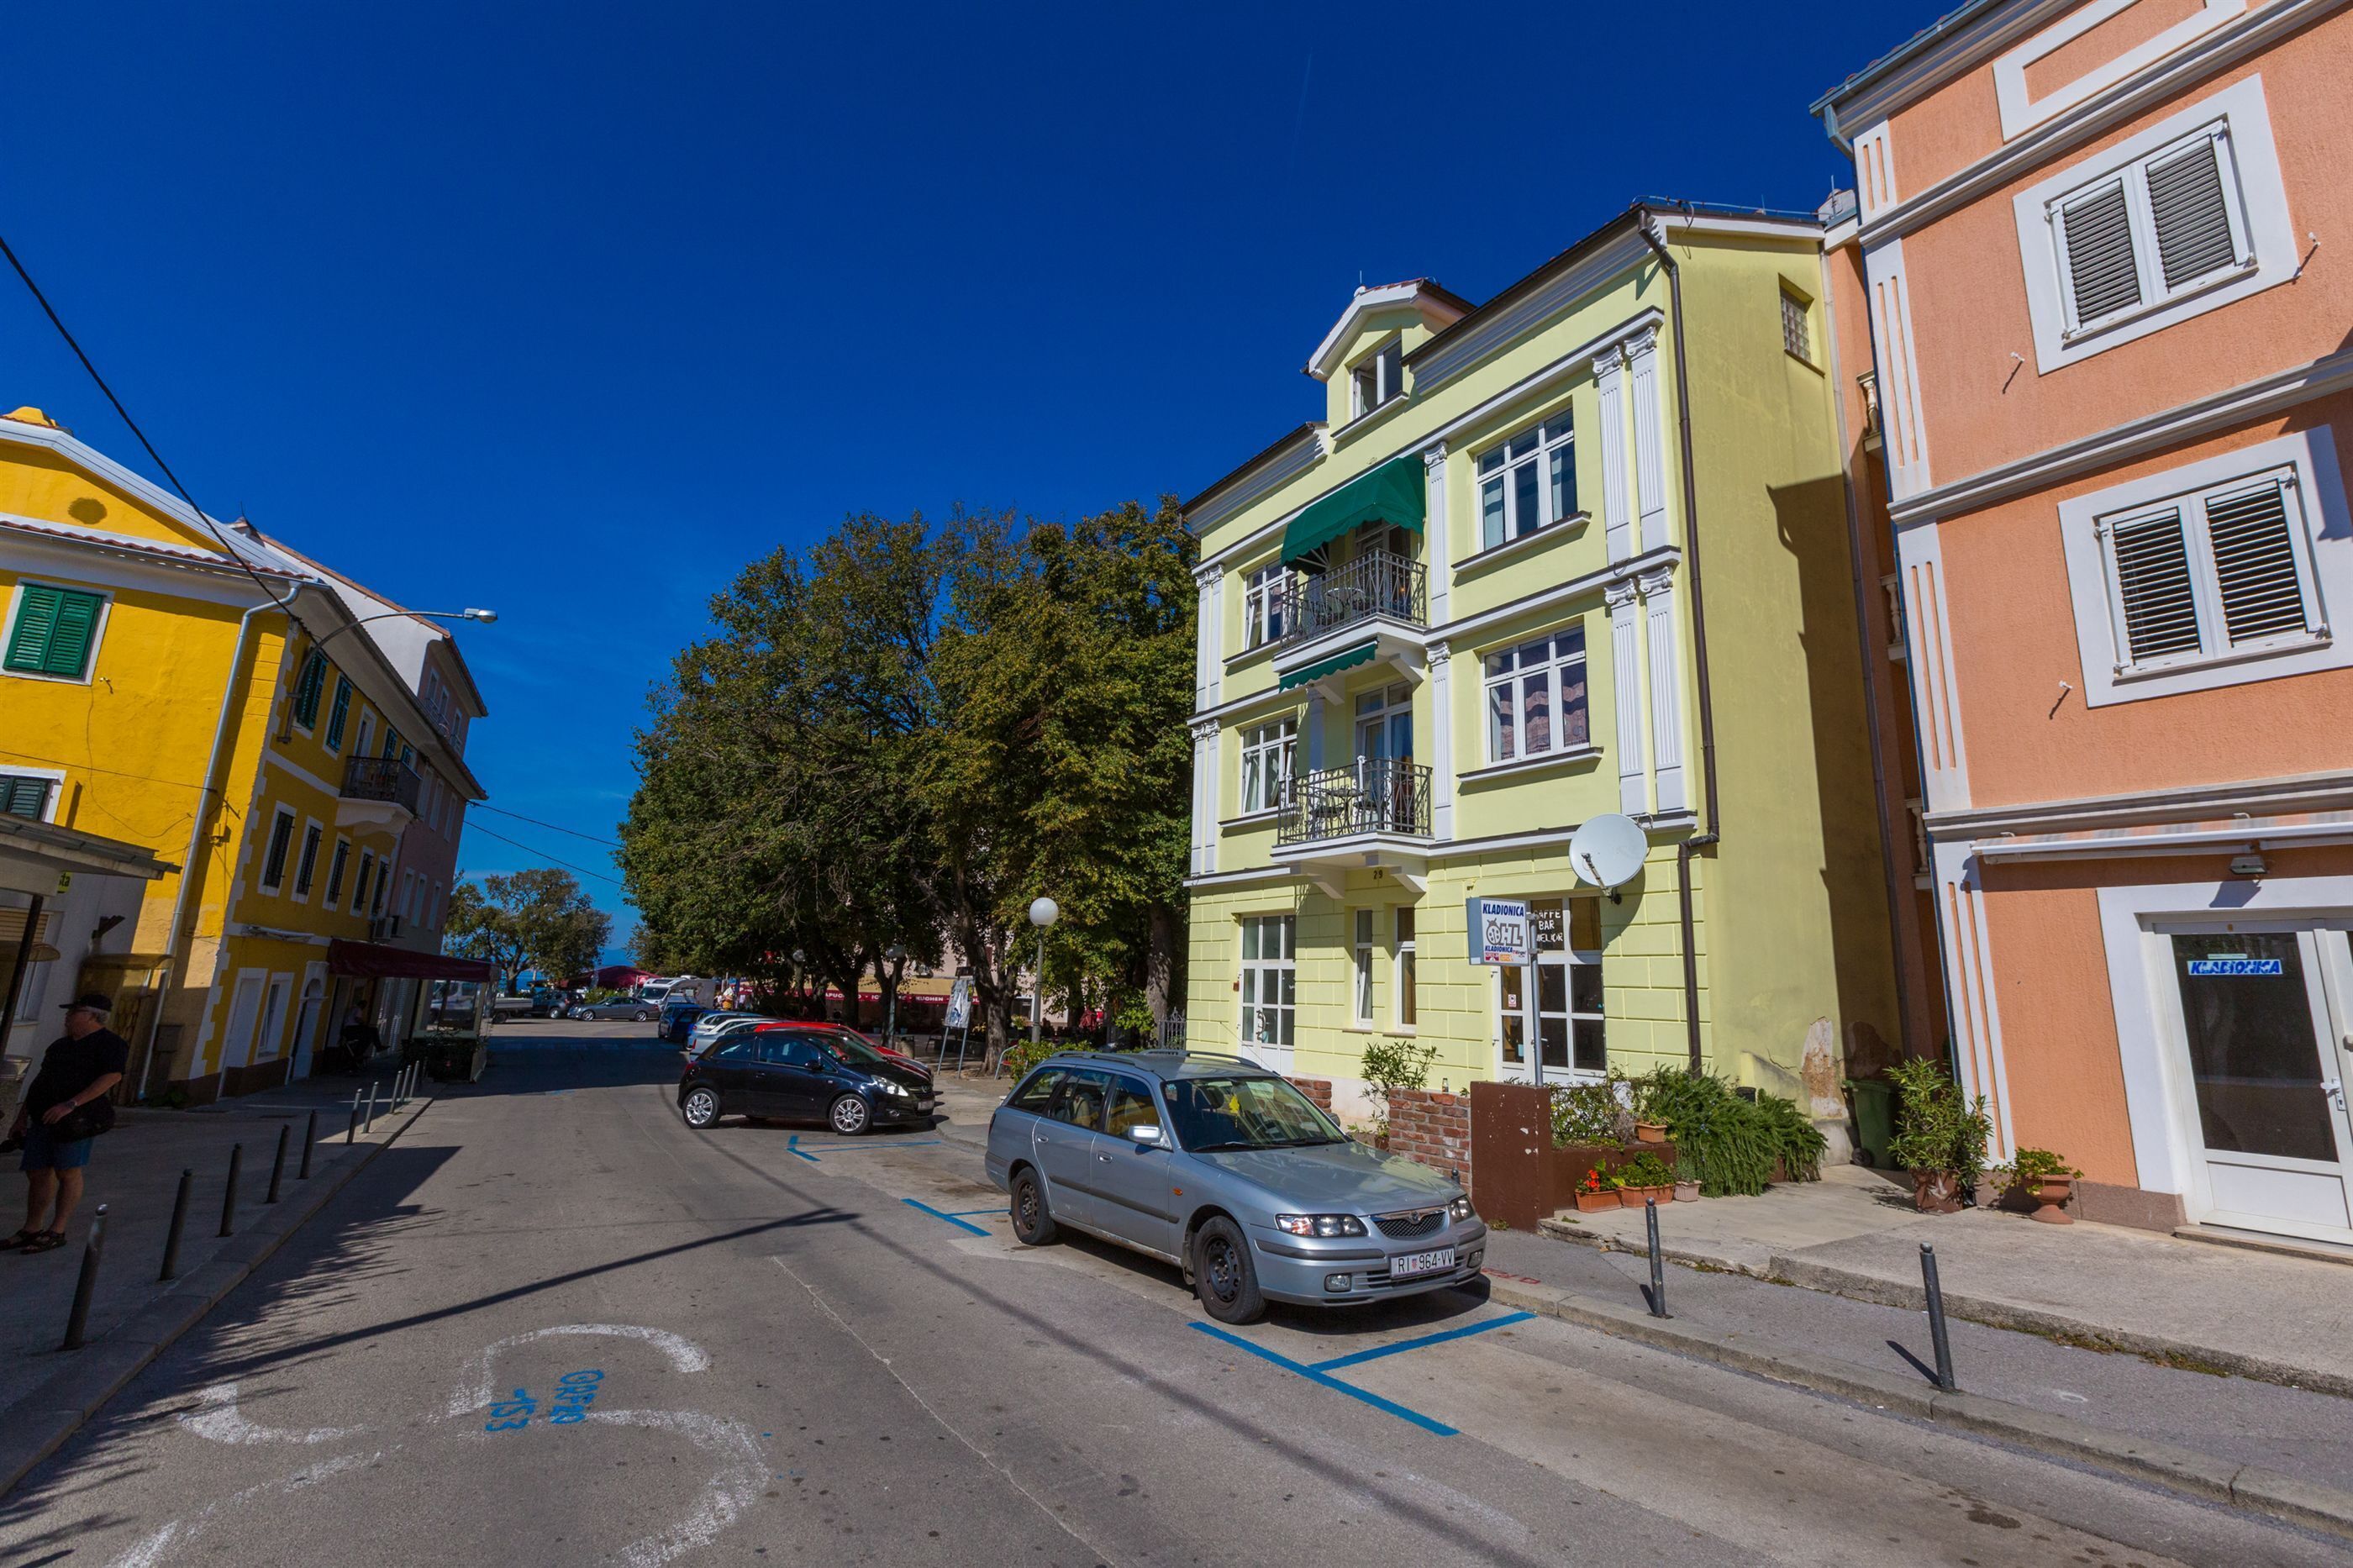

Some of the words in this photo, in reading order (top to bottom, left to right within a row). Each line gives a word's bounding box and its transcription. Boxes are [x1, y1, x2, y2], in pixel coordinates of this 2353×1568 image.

[1482, 903, 1524, 917] KLADIONICA
[1538, 920, 1555, 930] BAR
[1398, 1256, 1410, 1273] RI
[1419, 1250, 1453, 1270] 964-VV
